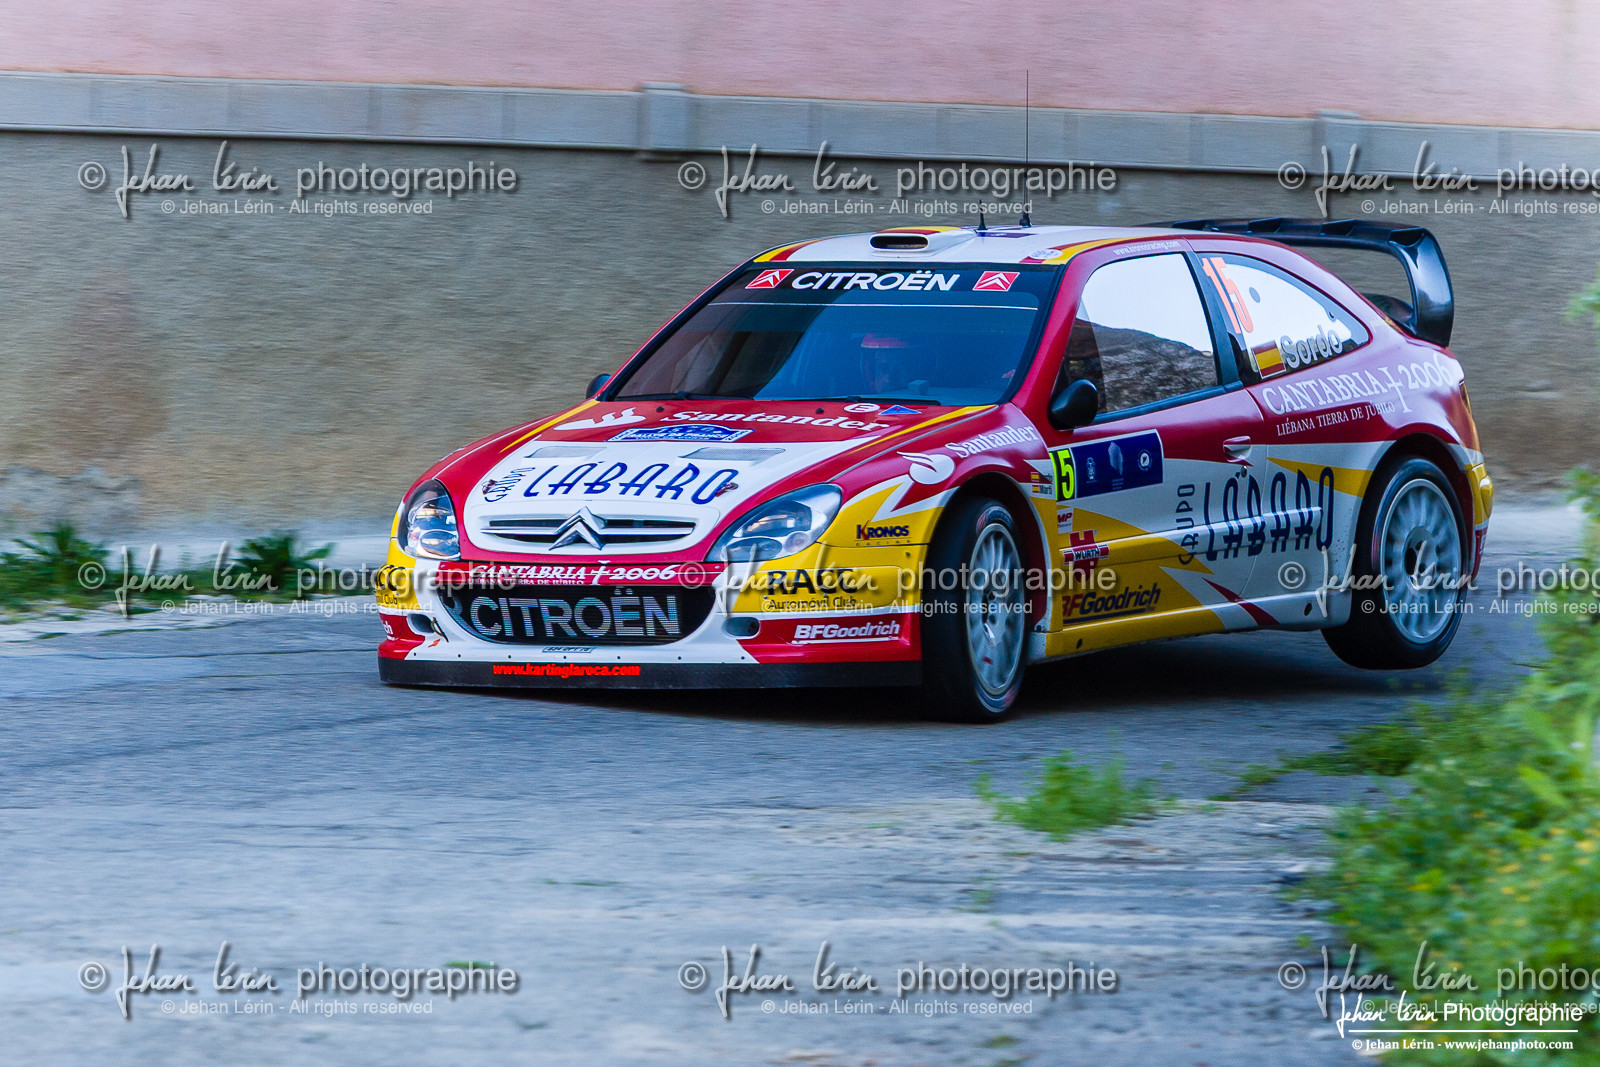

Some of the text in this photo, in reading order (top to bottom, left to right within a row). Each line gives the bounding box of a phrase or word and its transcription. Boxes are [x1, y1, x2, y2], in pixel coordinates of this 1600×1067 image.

[791, 270, 960, 292] CITROËN
[1201, 257, 1254, 335] 15
[1279, 329, 1344, 369] Sordo
[1262, 353, 1453, 415] CANTABRIA 2006
[660, 410, 890, 431] Santander
[1276, 417, 1316, 436] LIÉBANA
[1316, 411, 1349, 428] TIERRA
[1350, 406, 1364, 420] DE
[944, 424, 1039, 458] Santander
[856, 521, 910, 540] KRONOS
[1176, 483, 1199, 565] GRUPO
[469, 564, 681, 581] CANTABRIA 2006
[767, 569, 858, 595] RACC
[470, 587, 681, 637] CITROËN
[833, 595, 857, 608] Club
[793, 620, 900, 639] BFGoodrich
[492, 662, 641, 679] www.kartinglaroca.com
